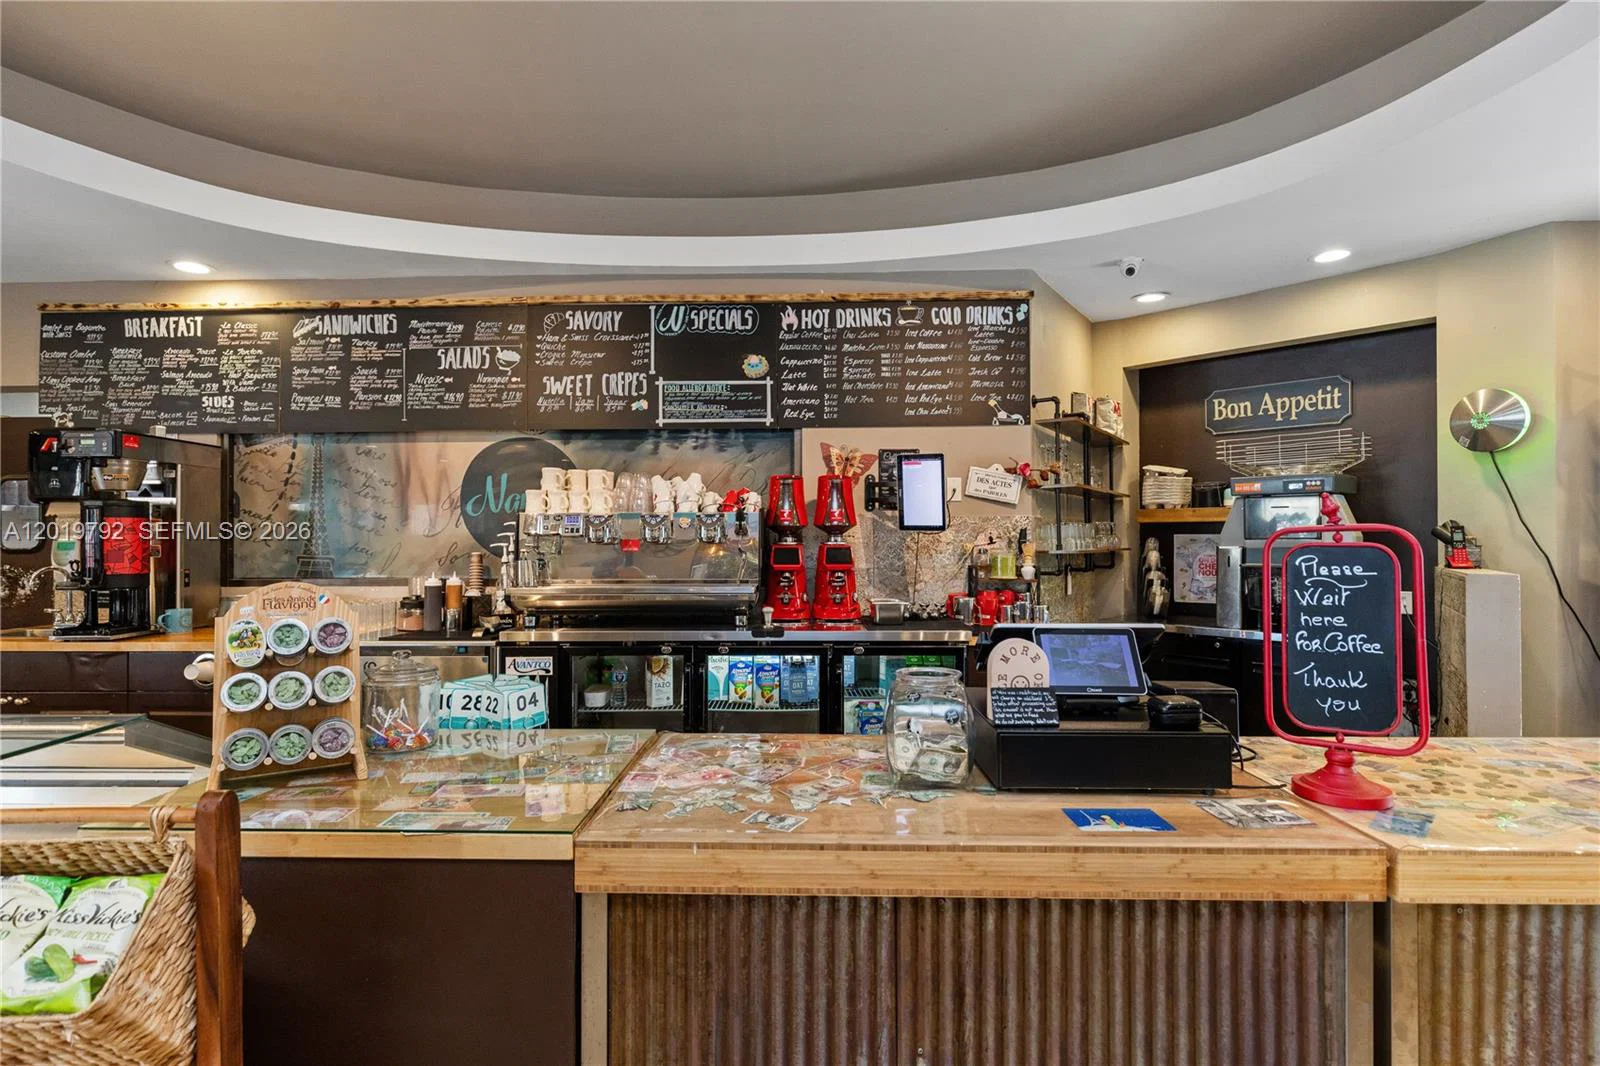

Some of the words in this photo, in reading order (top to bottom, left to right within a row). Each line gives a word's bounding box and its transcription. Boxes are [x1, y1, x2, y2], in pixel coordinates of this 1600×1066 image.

[315, 314, 397, 335] SANDWICHES
[565, 310, 622, 332] SAVORY
[690, 309, 753, 330] SPECIALS
[801, 309, 830, 329] HOT
[836, 308, 892, 328] DRINKS
[931, 307, 961, 325] COLD
[966, 306, 1014, 325] DRINKS
[124, 316, 203, 338] BREAKFAST
[437, 346, 490, 369] SALADS
[542, 374, 593, 396] SWEET
[602, 372, 647, 396] CREPES
[202, 396, 234, 408] SIDES
[1212, 398, 1253, 420] Bon
[1258, 385, 1342, 421] Appetit
[466, 472, 526, 517] Na
[1199, 563, 1217, 571] CHE
[1295, 554, 1378, 577] Please
[262, 598, 317, 611] Flavigny
[1294, 586, 1351, 607] Wait
[1300, 612, 1348, 627] here
[508, 658, 551, 673] AVANTCO
[999, 645, 1041, 665] MORE
[654, 681, 671, 689] TAZO
[1293, 662, 1368, 689] Thank
[461, 694, 481, 711] 28
[485, 696, 499, 714] 22
[517, 692, 539, 711] 04
[1316, 697, 1361, 718] you
